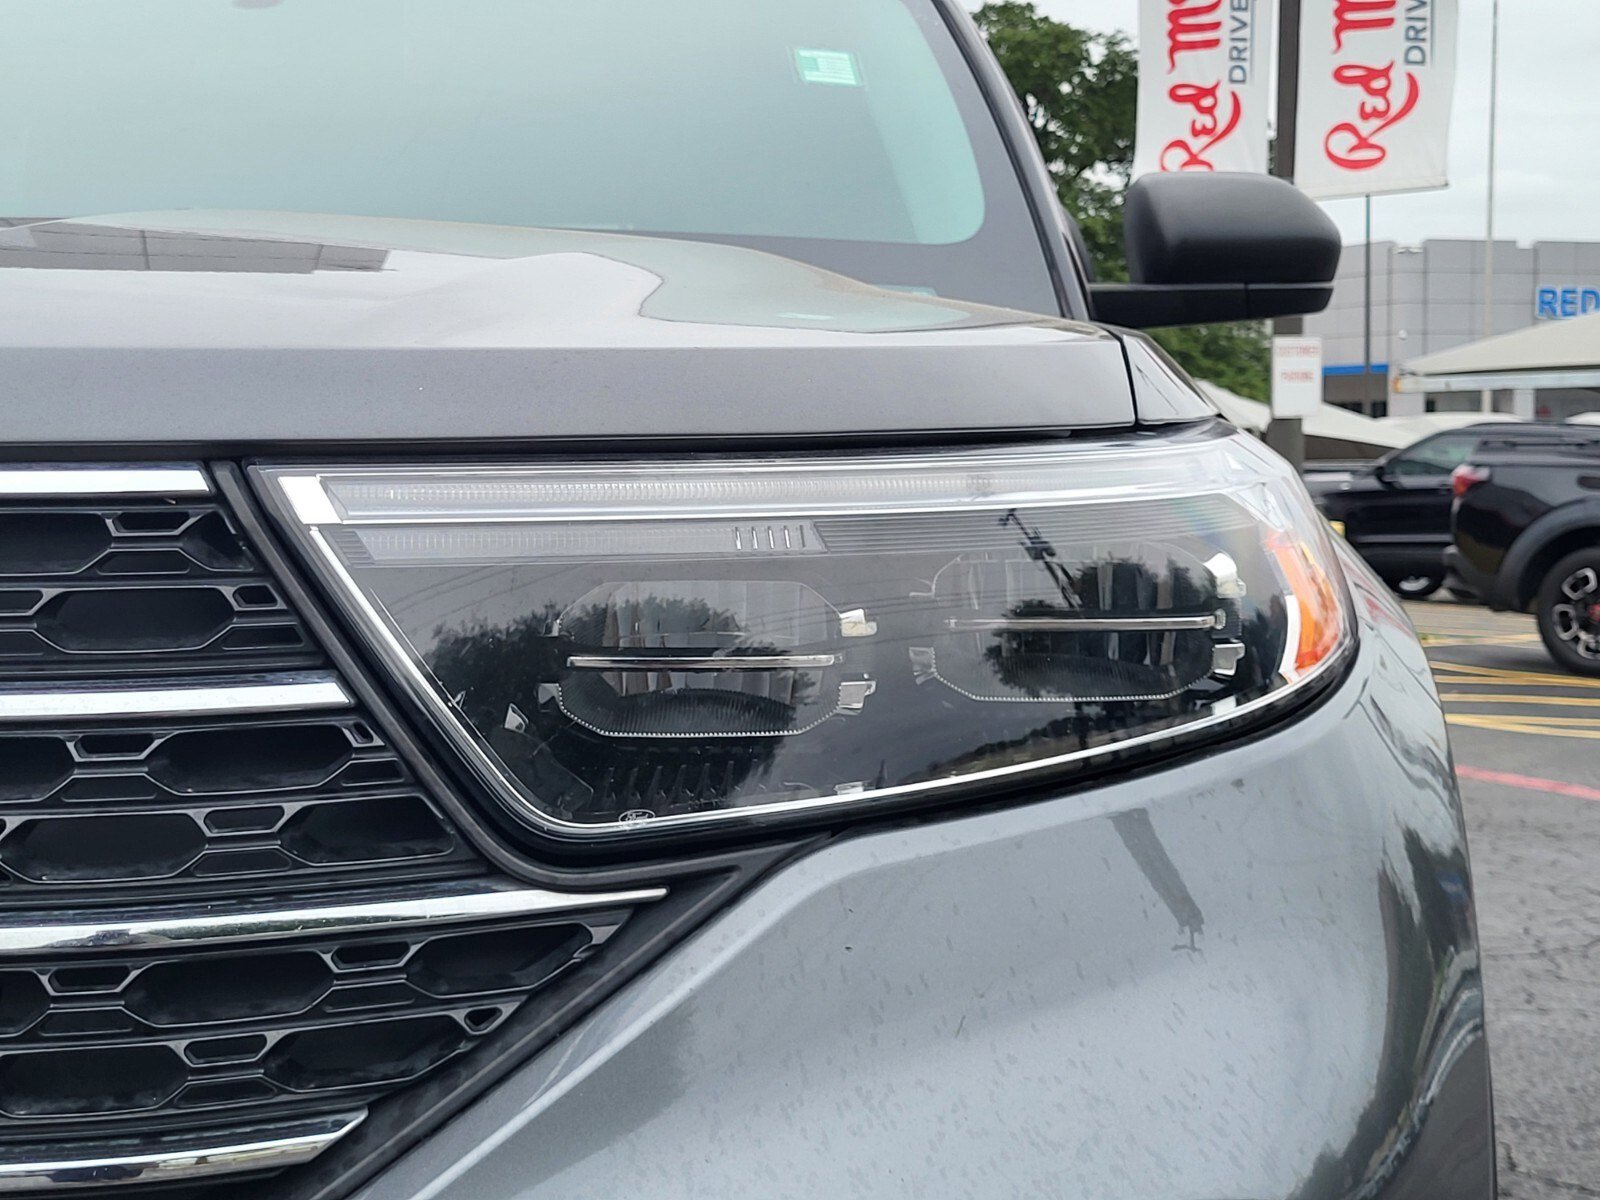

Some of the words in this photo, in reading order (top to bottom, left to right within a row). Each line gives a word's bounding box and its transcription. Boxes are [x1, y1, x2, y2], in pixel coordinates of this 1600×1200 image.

[1160, 80, 1241, 171] Red
[1325, 60, 1419, 170] Red
[1537, 288, 1600, 317] RED
